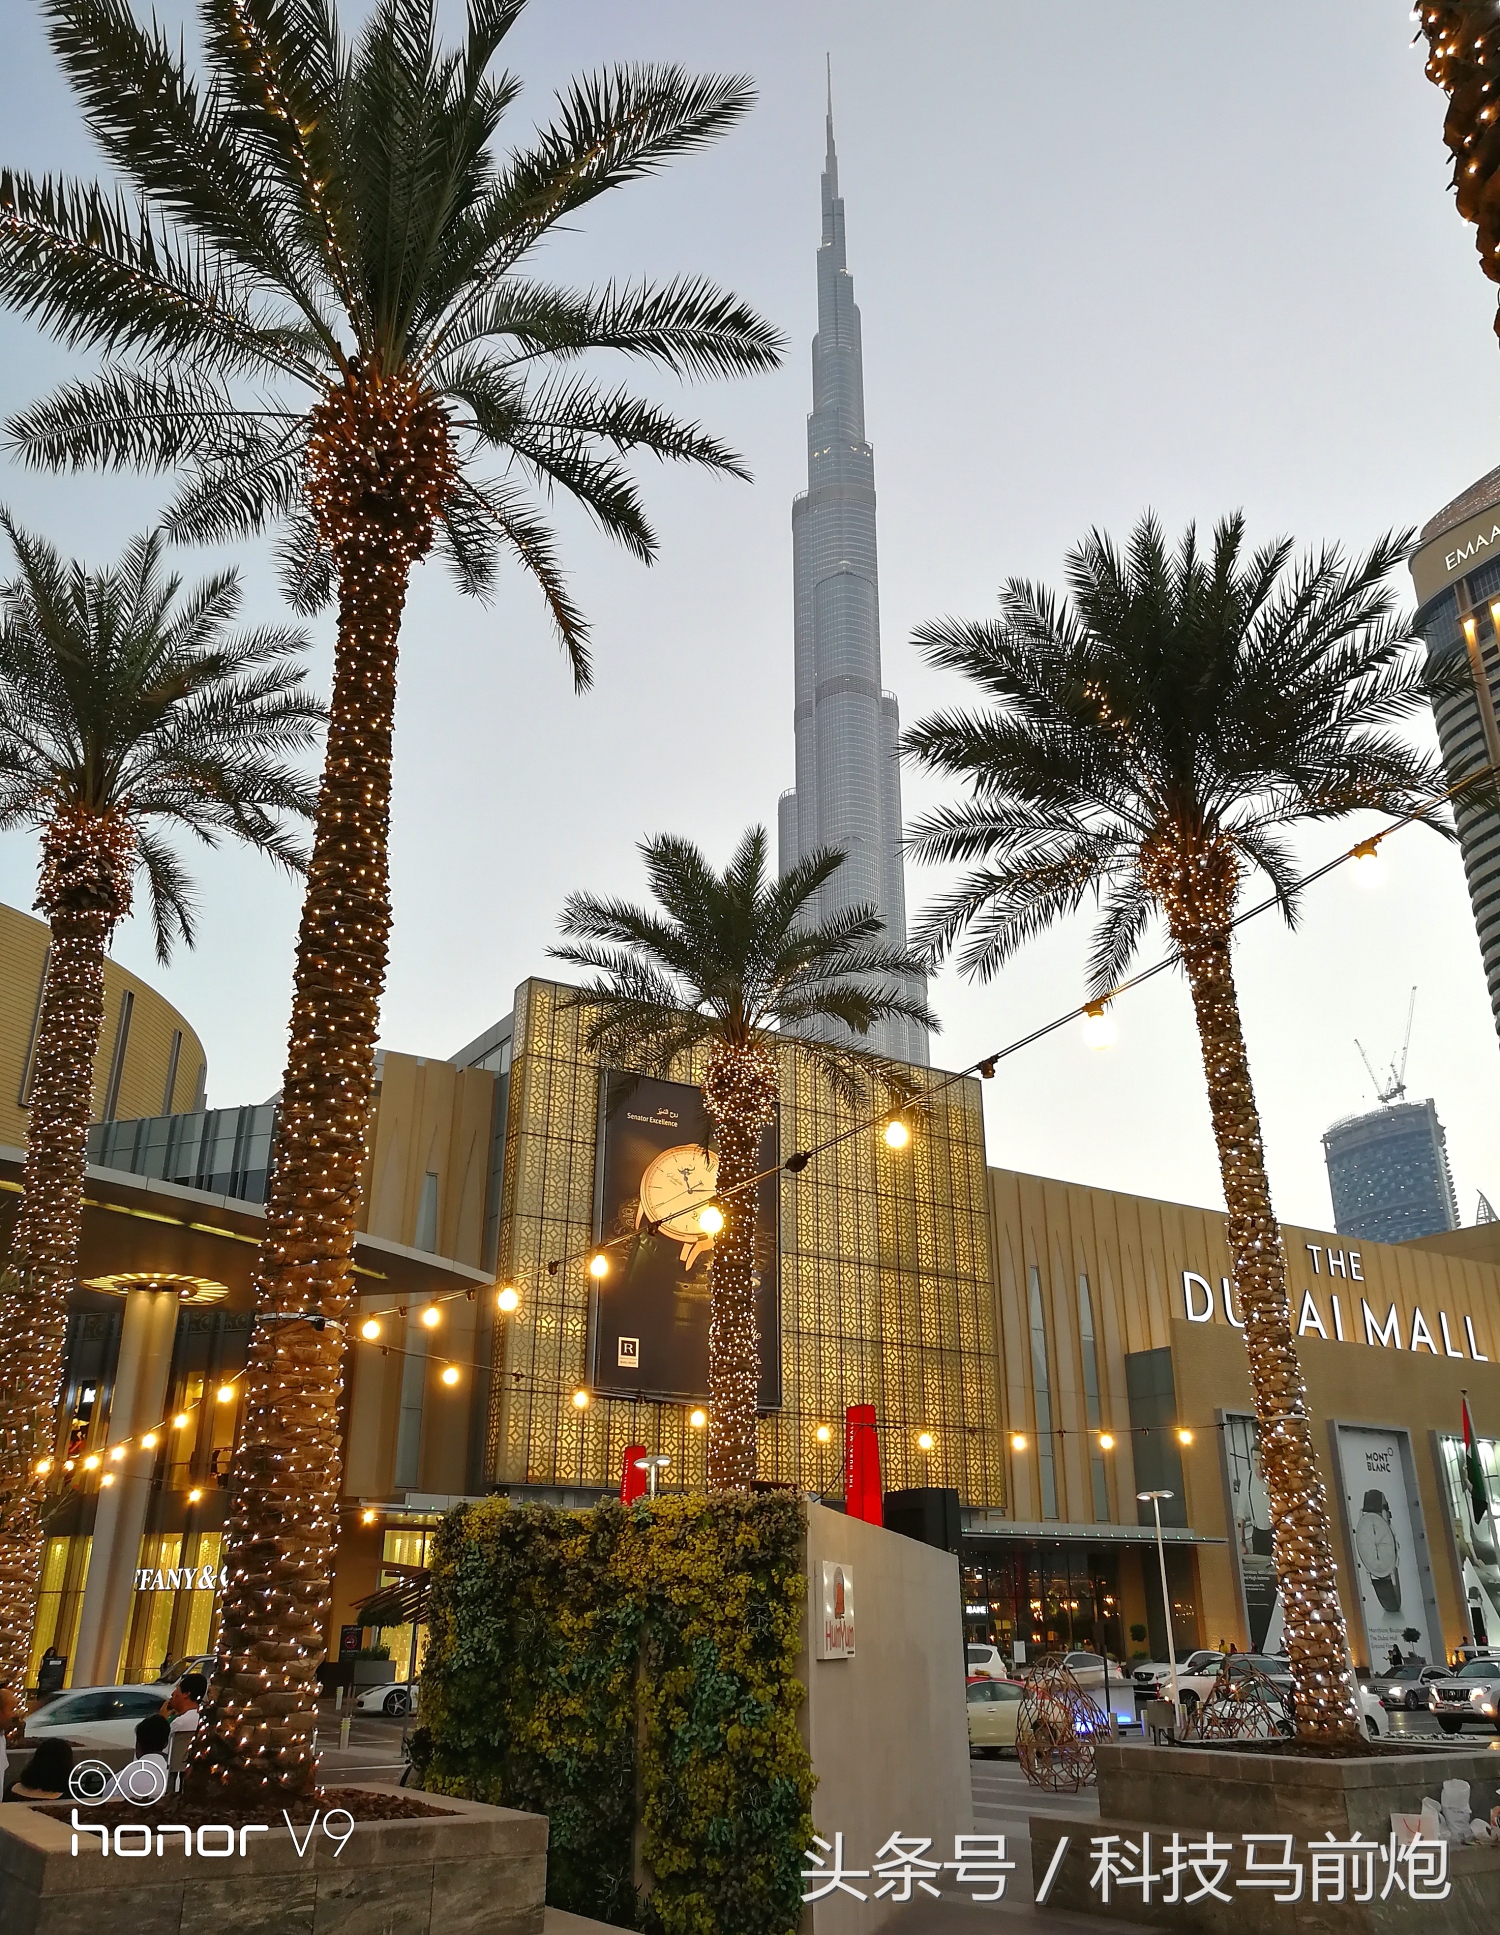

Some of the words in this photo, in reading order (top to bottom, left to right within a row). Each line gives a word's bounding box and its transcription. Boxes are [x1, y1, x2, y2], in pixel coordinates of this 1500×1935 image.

[626, 1112, 649, 1123] Senator
[649, 1116, 679, 1128] Excellence
[1306, 1244, 1364, 1281] THE
[1182, 1270, 1344, 1342] DUAI
[1361, 1297, 1489, 1362] MALL
[1365, 1451, 1388, 1462] MONT
[1366, 1461, 1391, 1473] BLANC
